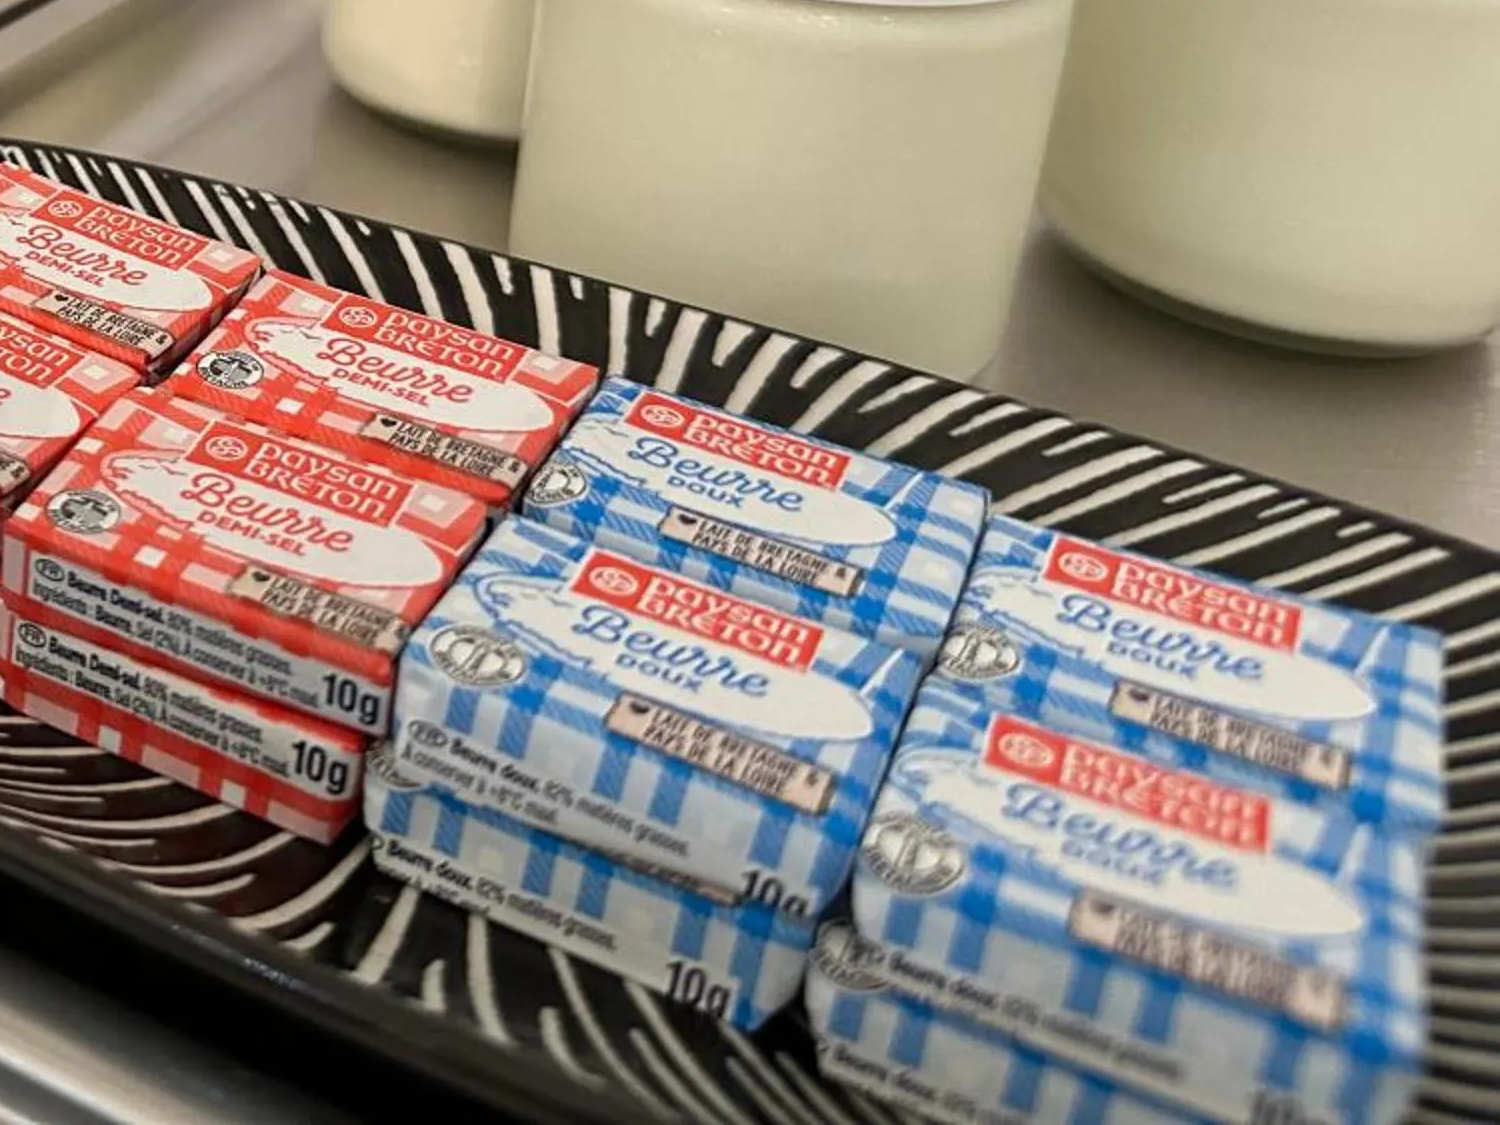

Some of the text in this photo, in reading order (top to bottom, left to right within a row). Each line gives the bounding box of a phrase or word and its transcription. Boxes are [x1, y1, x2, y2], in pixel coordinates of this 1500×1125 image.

[13, 221, 159, 287] Beurre
[21, 249, 110, 287] DEMI-SEL
[313, 333, 483, 405] Beurre
[330, 366, 434, 406] DEMI-SEL
[620, 433, 814, 514] Beurre
[662, 474, 746, 508] DOUX
[174, 468, 367, 553] Beurre
[193, 509, 312, 557] DEMI-SEL
[563, 600, 782, 700] Beurre
[1051, 590, 1269, 683] Beurre
[319, 669, 380, 728] 10g
[610, 651, 707, 693] DOUX
[286, 735, 351, 798] 10g
[449, 736, 497, 773] Beurre
[996, 777, 1244, 891] Beurre
